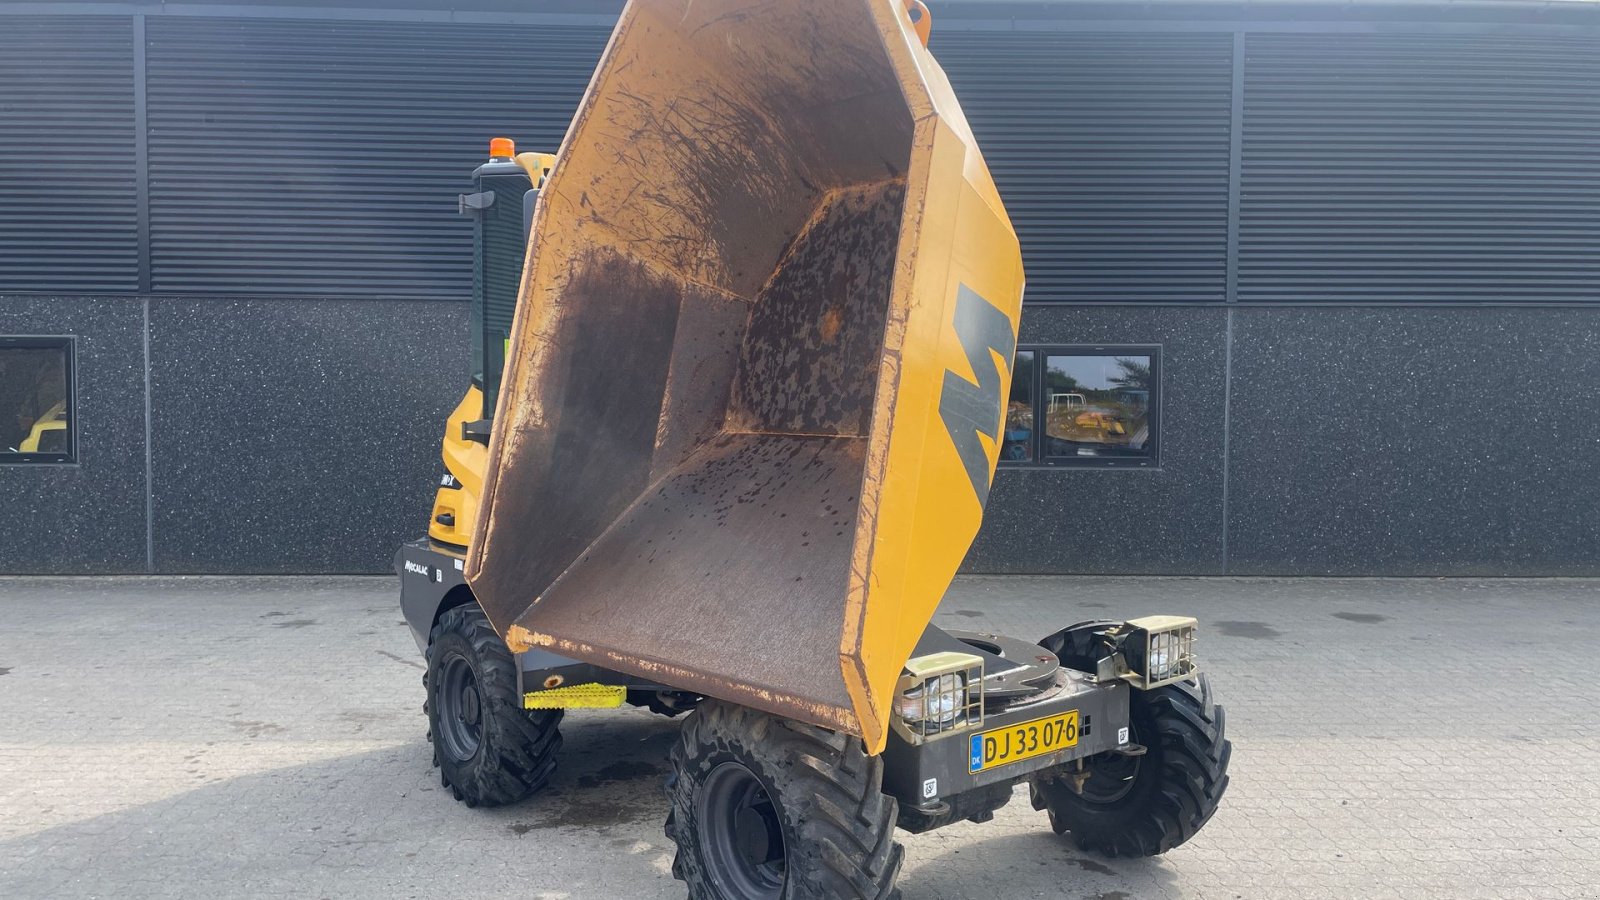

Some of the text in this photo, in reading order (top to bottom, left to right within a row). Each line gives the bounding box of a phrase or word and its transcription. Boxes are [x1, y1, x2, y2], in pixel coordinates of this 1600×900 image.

[985, 716, 1076, 763] DJ 33 076
[972, 756, 981, 765] DK
